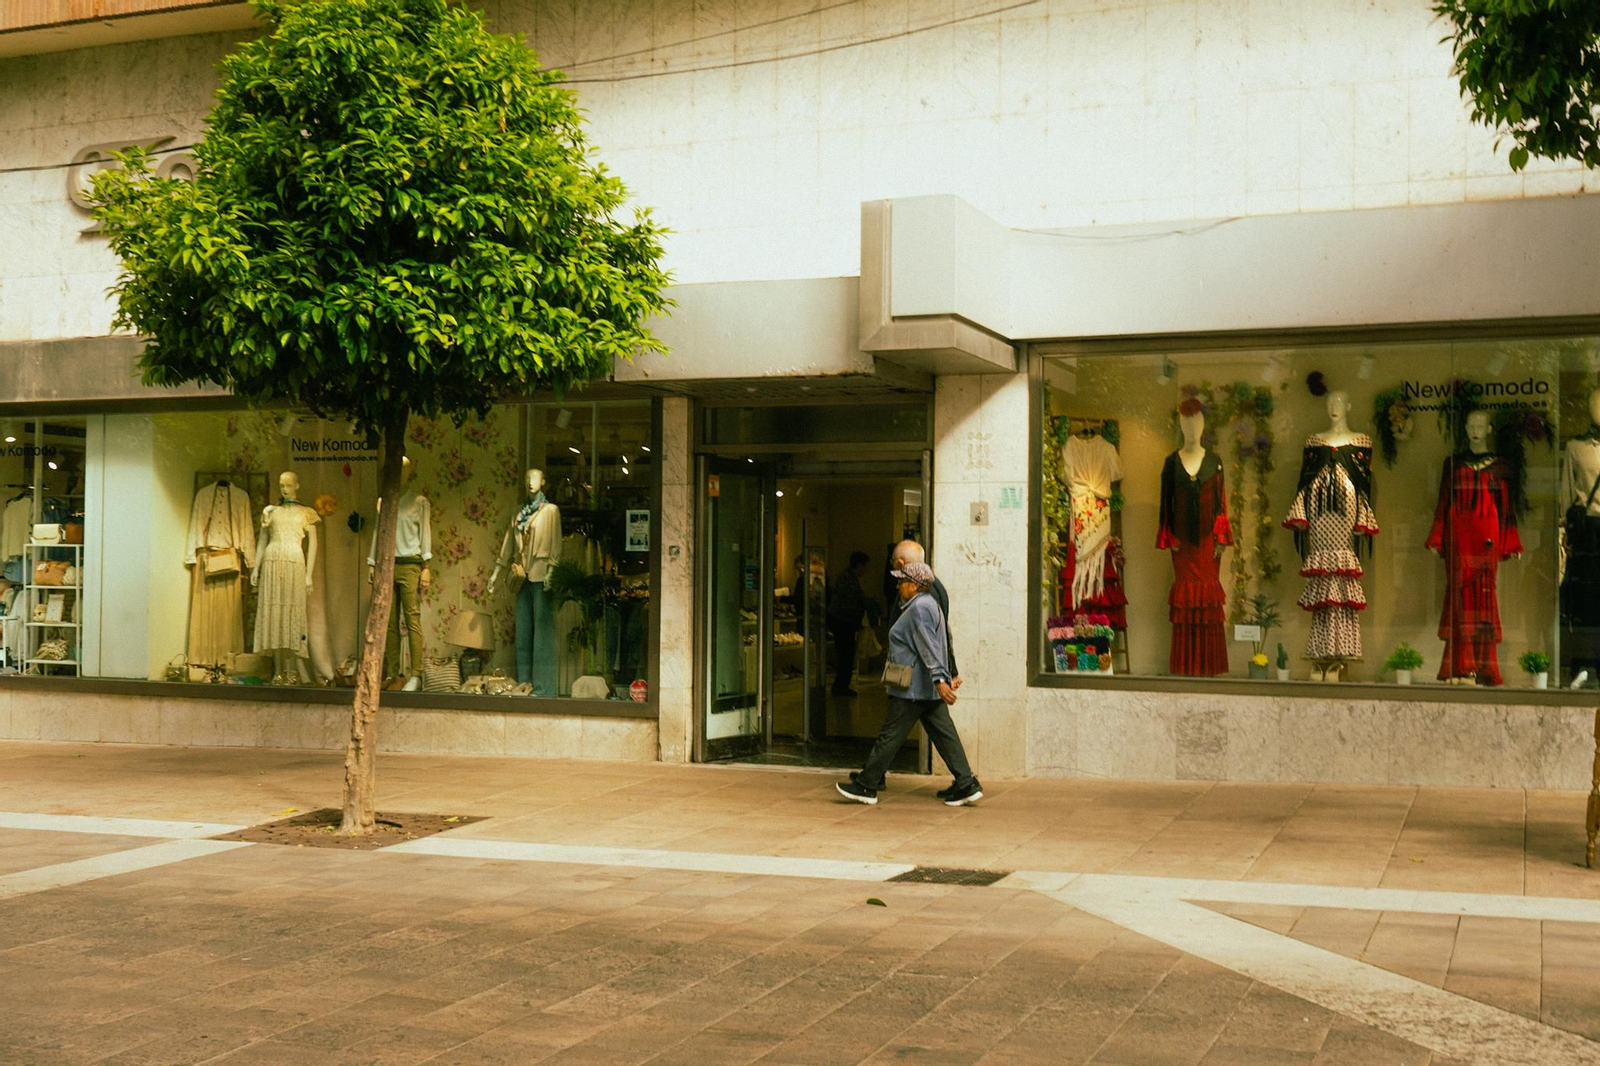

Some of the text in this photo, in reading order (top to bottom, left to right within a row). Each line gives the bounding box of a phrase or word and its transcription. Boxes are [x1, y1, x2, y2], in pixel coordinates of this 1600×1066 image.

[1404, 376, 1550, 398] New Komodo
[291, 437, 320, 452] New
[293, 454, 379, 462] www.newkomodo.es
